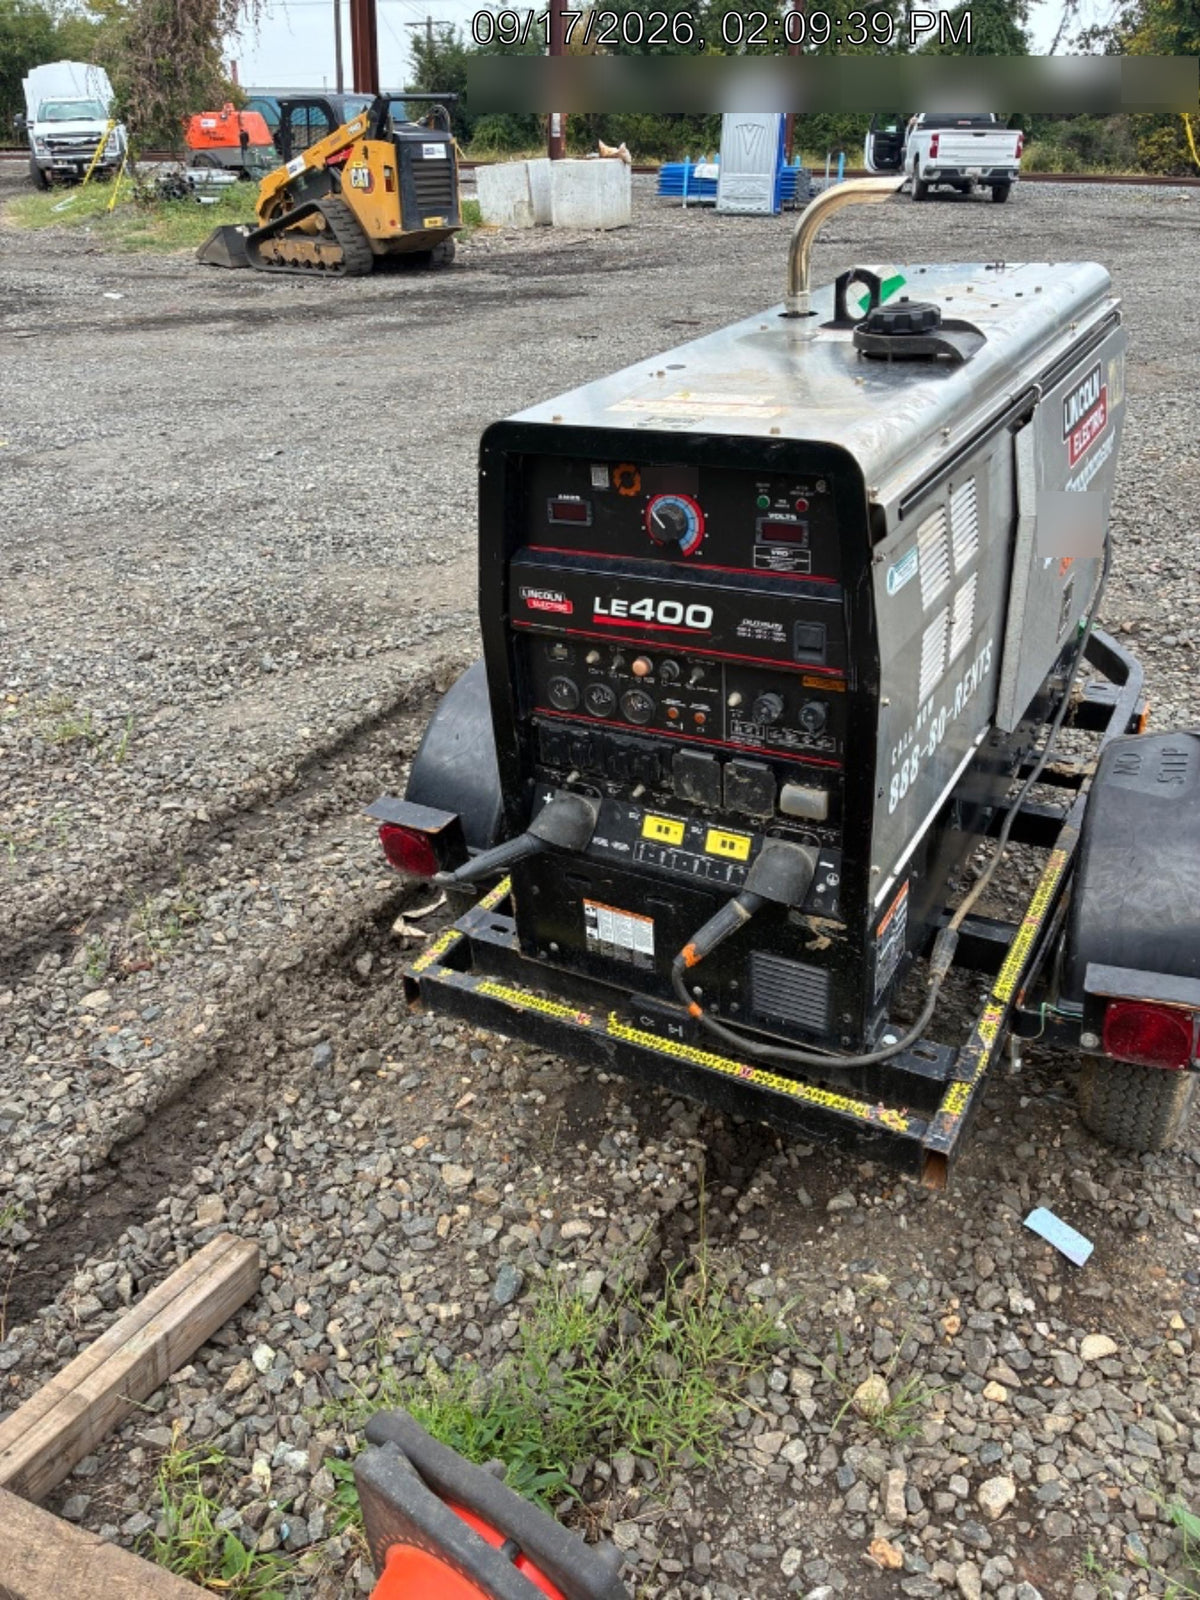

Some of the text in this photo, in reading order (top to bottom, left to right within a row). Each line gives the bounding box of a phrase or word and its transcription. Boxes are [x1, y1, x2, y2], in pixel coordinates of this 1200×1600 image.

[351, 168, 369, 188] CAT
[1064, 368, 1100, 434] LINCOLN
[768, 512, 798, 521] VOLTS
[522, 588, 563, 602] LINCOLN
[593, 597, 713, 629] LE400
